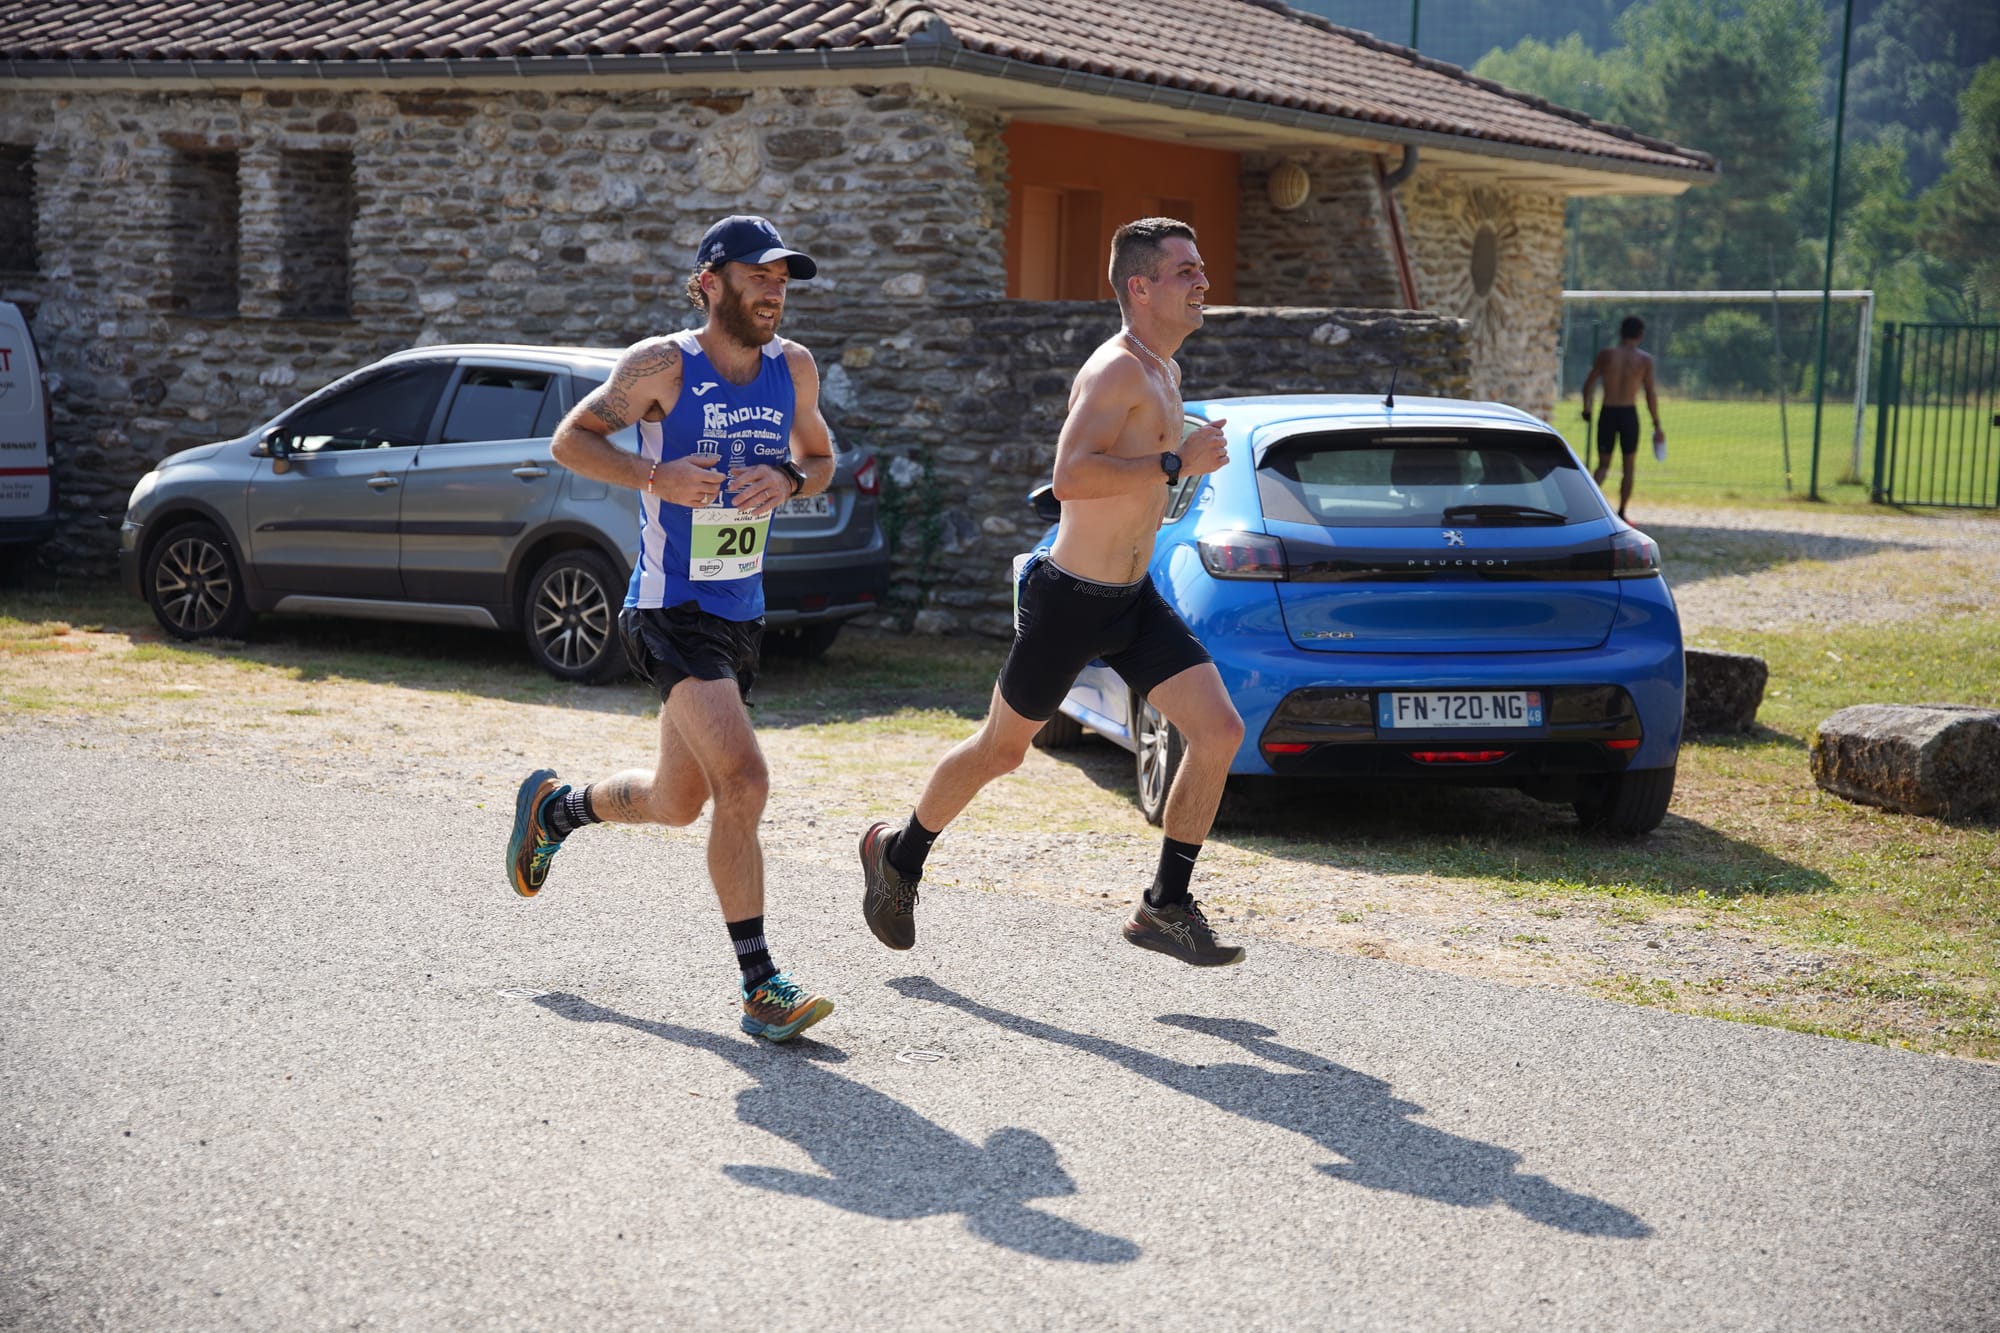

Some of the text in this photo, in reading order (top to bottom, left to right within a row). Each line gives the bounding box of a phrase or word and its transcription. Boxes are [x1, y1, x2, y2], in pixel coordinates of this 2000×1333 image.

[716, 527, 756, 556] 20
[1398, 695, 1522, 720] FN-720-NG
[1528, 710, 1542, 722] 48
